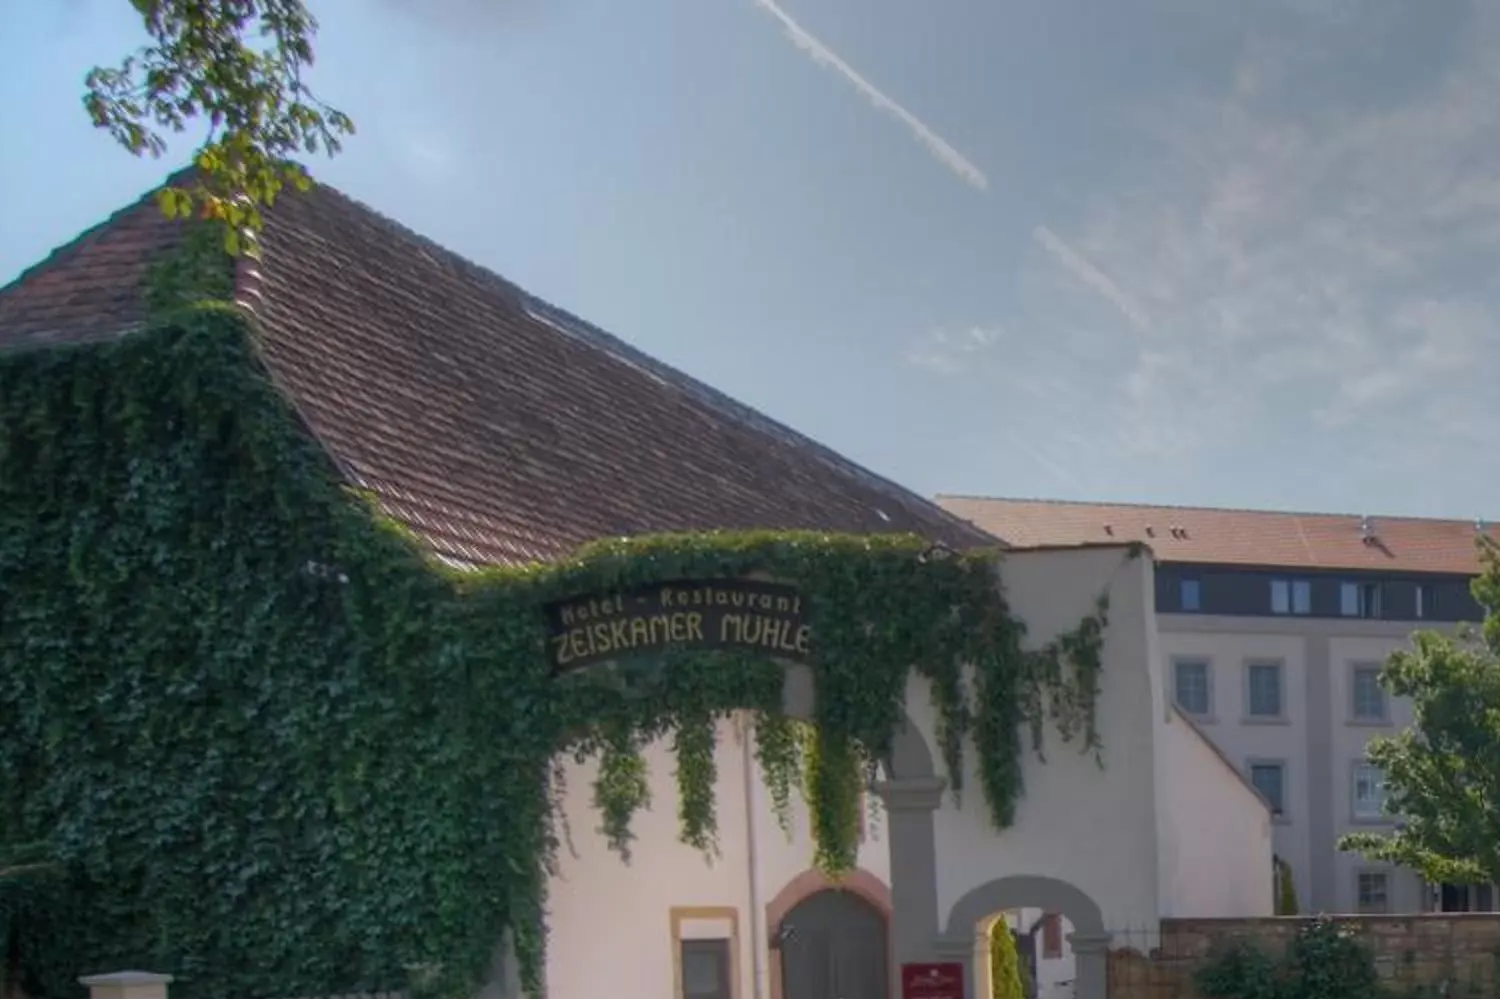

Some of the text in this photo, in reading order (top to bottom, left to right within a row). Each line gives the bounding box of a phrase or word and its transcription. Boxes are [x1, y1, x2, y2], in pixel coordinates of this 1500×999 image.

[561, 594, 623, 625] Hotel
[660, 587, 801, 614] Restaurant
[552, 612, 704, 665] ZEISKAMER
